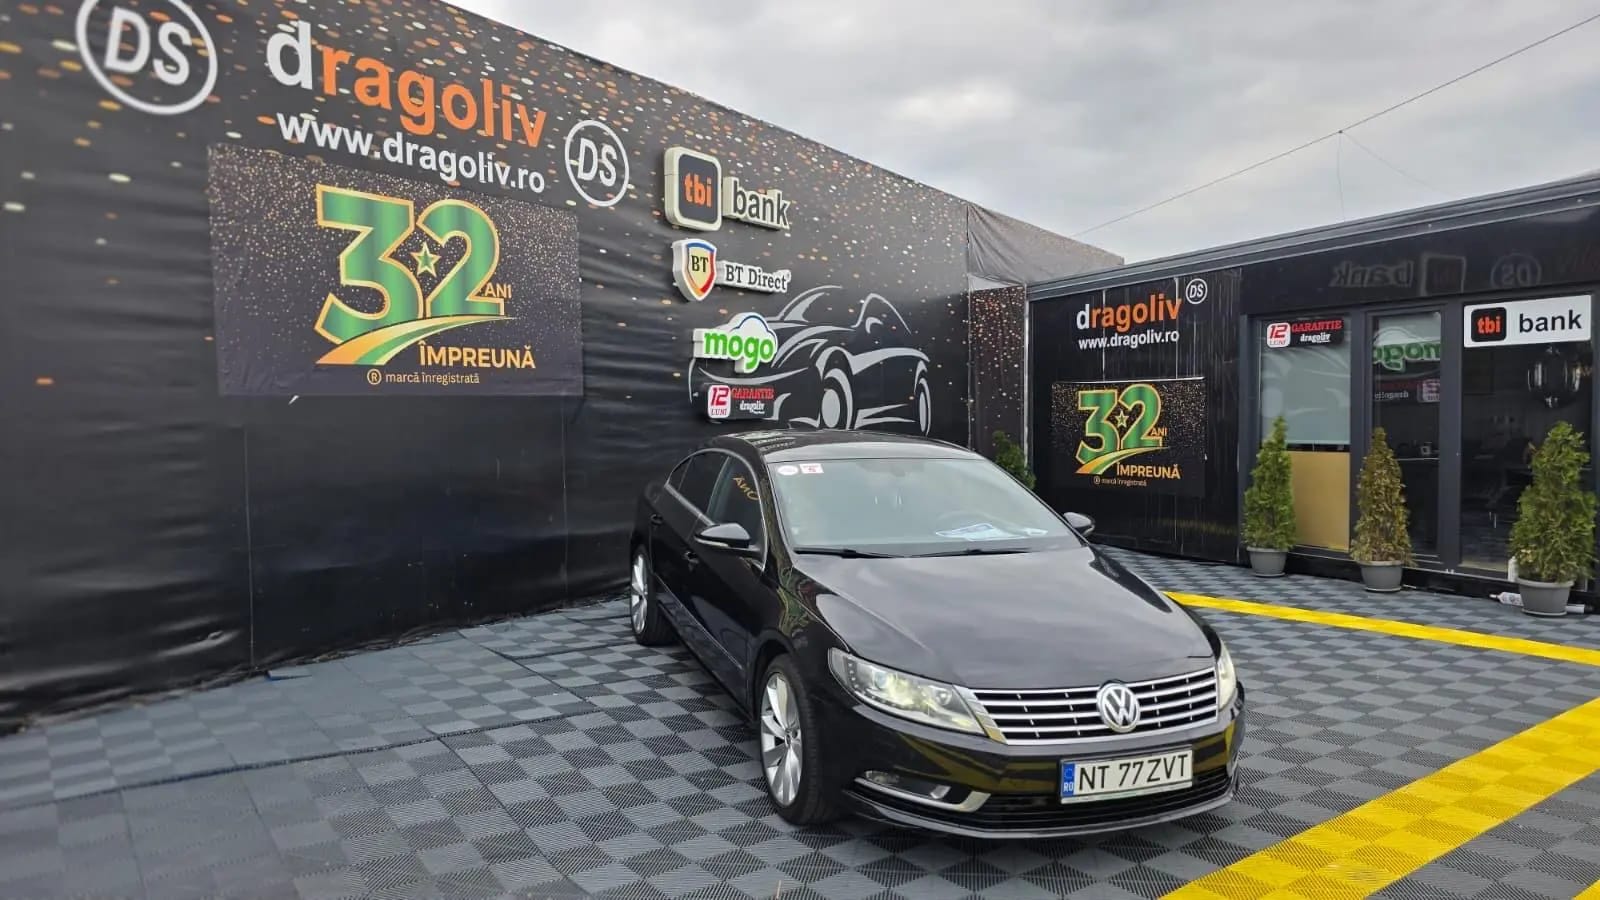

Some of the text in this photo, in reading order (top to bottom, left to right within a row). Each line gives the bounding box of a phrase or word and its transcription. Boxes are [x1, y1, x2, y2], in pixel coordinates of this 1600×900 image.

[103, 6, 193, 85] DS
[266, 21, 547, 149] dragoliv
[276, 112, 545, 193] www.dragoliv.ro
[577, 137, 618, 187] DS
[684, 172, 788, 226] tbi bank
[315, 183, 504, 346] 32
[691, 255, 709, 273] BT
[725, 264, 787, 290] BT Direct
[484, 283, 512, 299] ANI
[1189, 284, 1204, 299] DS
[1076, 293, 1182, 333] dragoliv
[1477, 309, 1582, 334] tbi bank
[1269, 324, 1288, 339] 12
[1291, 320, 1343, 333] GARANTIE
[1300, 332, 1332, 342] dragoliv
[704, 330, 775, 373] mogo
[1078, 329, 1180, 350] www.dragoliv.ro
[417, 340, 537, 369] ÎMPREUNĂ
[385, 372, 420, 383] marcă
[421, 371, 480, 385] înregistrată
[711, 387, 729, 406] 12
[1075, 383, 1163, 465] 32
[1150, 426, 1168, 437] ANI
[1116, 461, 1181, 480] ÎMPREUNĂ
[1063, 782, 1074, 791] RO
[1079, 765, 1109, 791] NT
